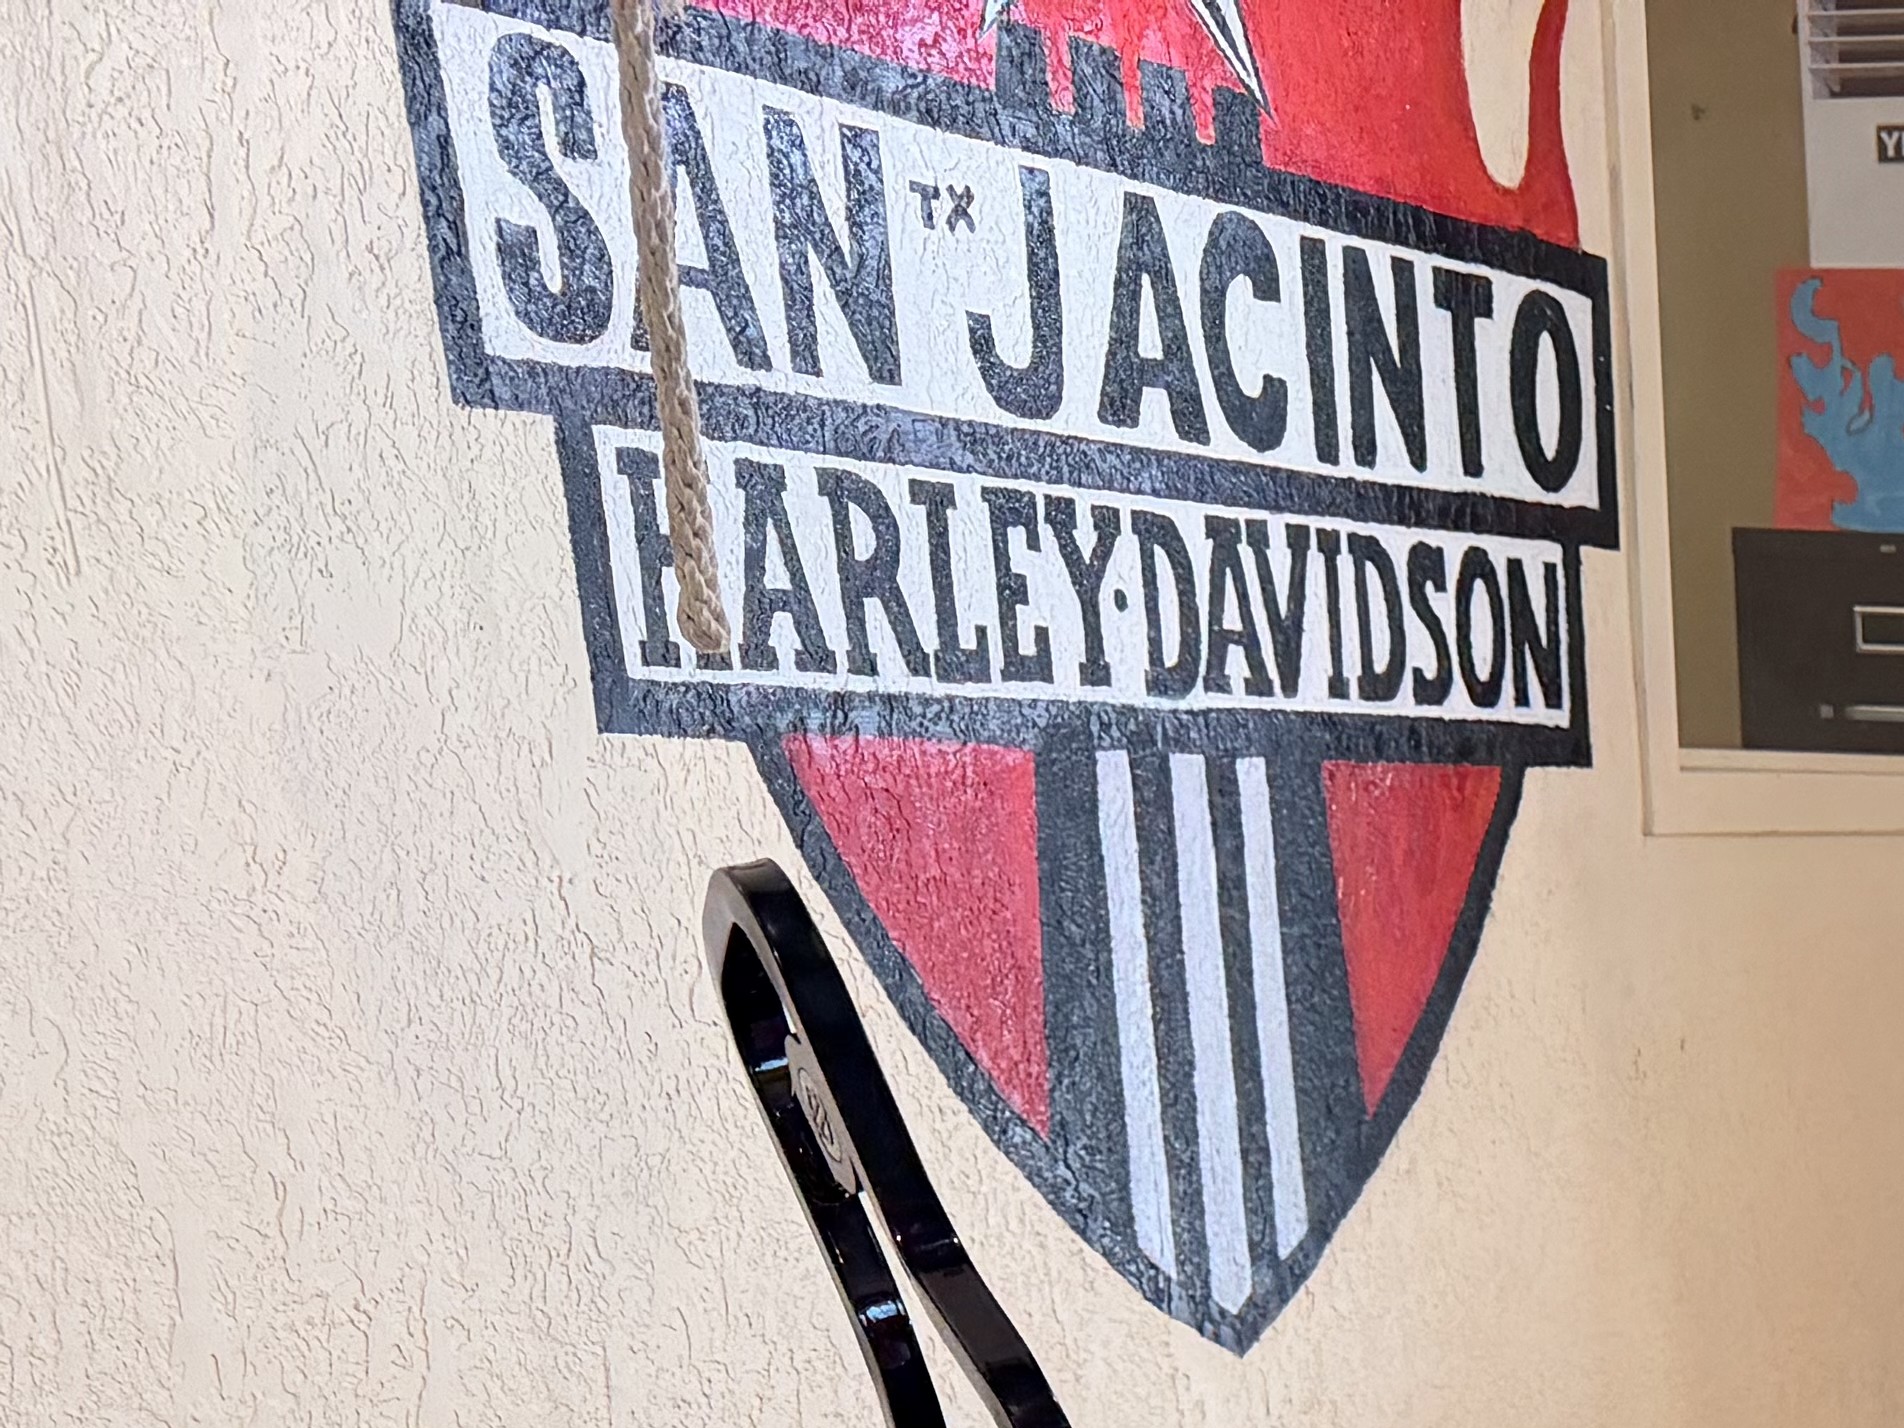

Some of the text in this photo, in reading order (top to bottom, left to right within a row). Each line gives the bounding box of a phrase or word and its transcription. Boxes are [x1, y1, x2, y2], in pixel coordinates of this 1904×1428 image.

[489, 32, 1583, 495] SAN TX JACINTO
